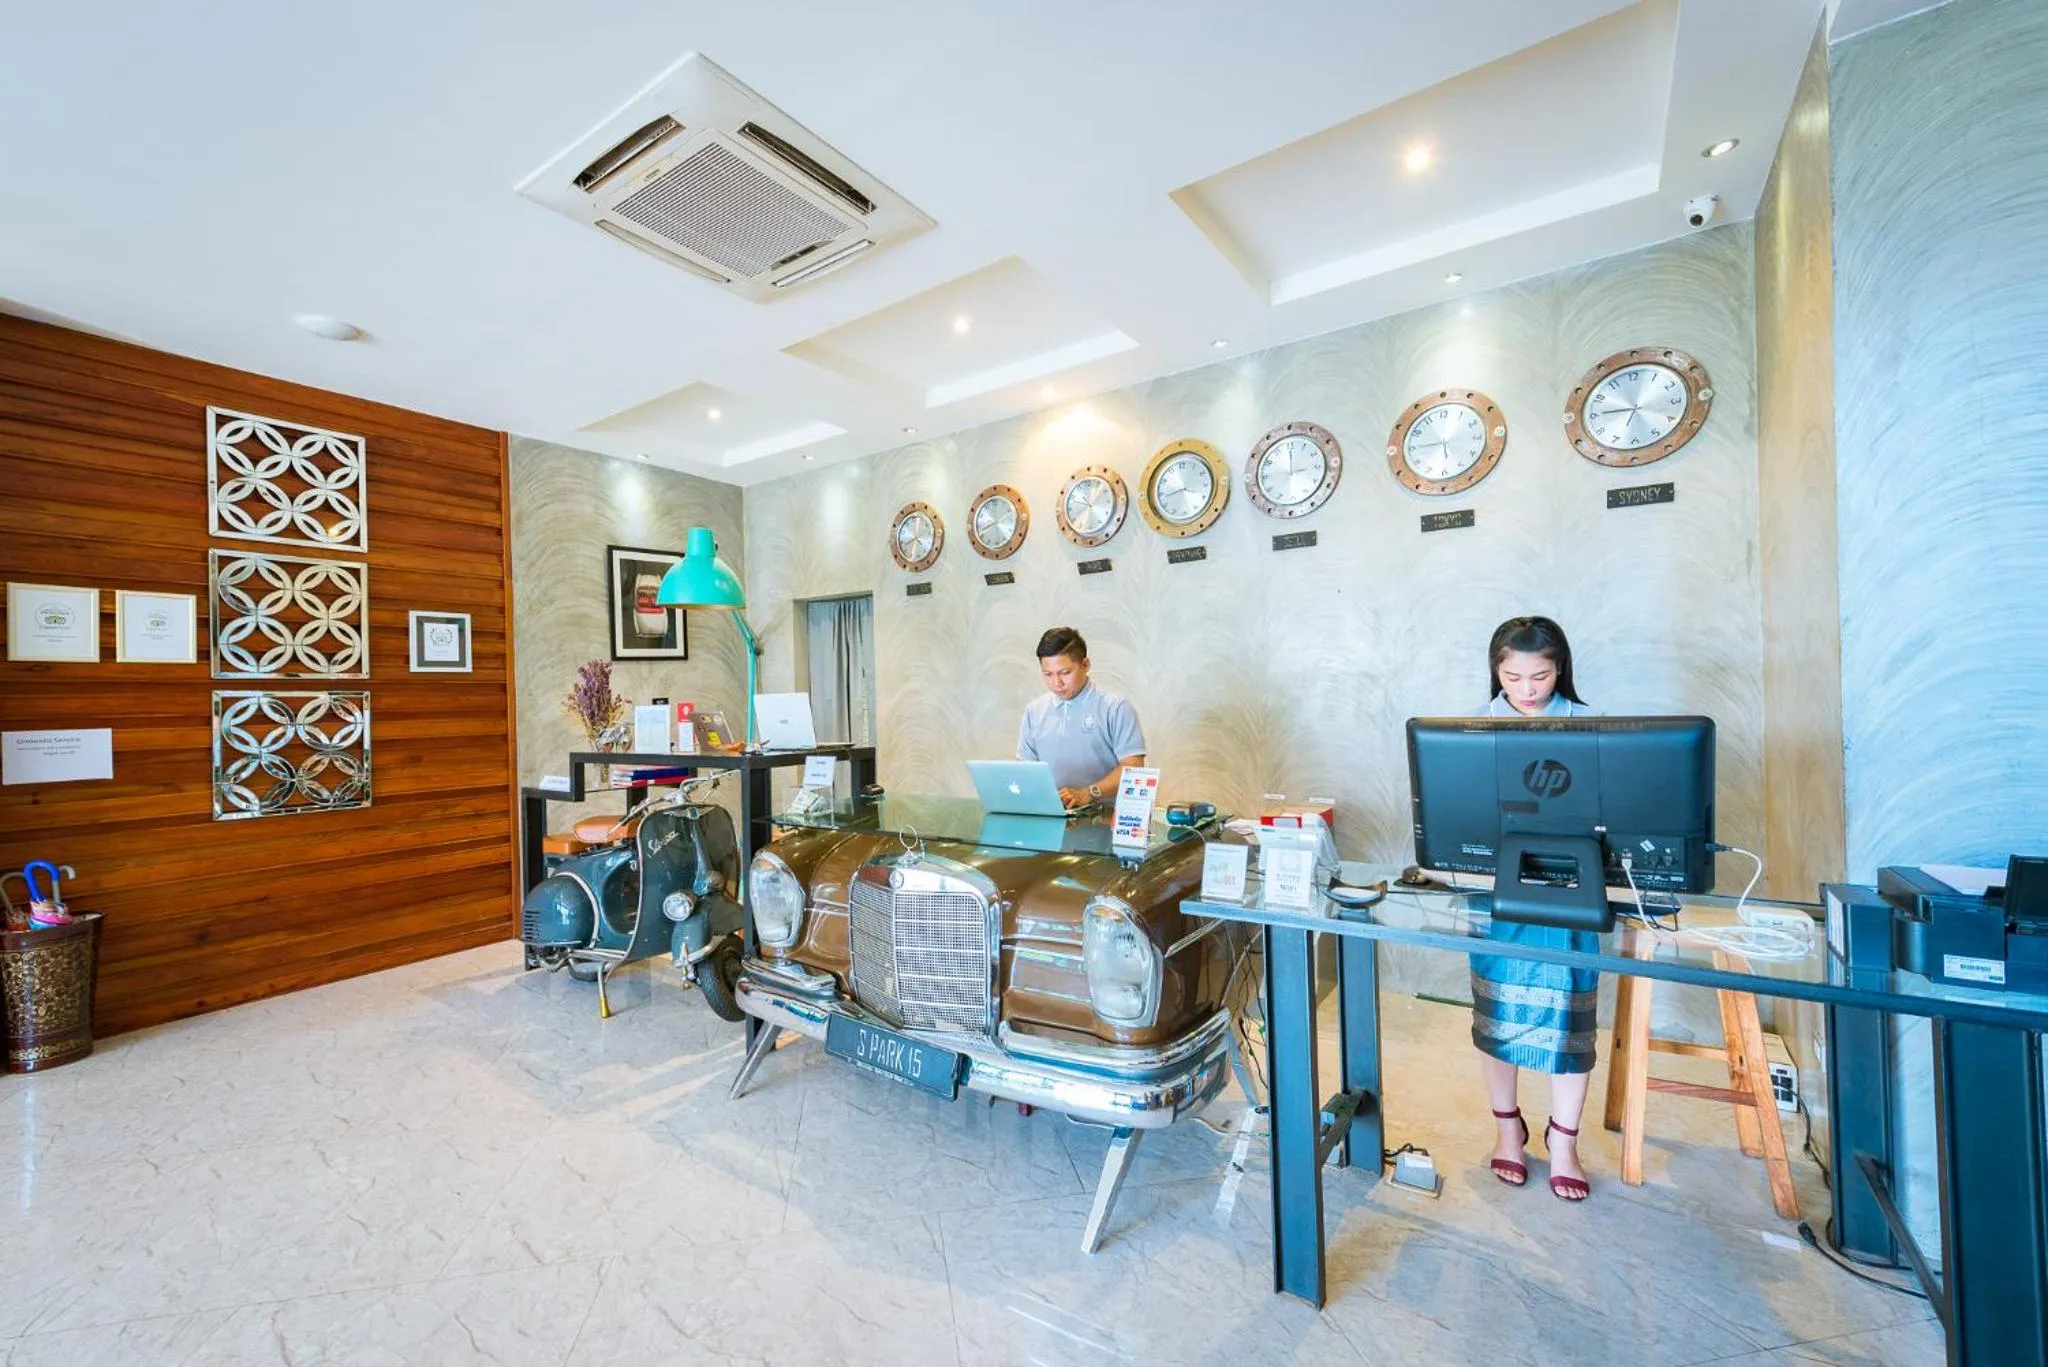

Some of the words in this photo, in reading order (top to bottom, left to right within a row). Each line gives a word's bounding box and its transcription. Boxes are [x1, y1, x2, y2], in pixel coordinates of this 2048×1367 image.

[1628, 372, 1639, 382] 12
[1651, 373, 1657, 382] 1
[1608, 380, 1621, 390] 11
[1665, 381, 1675, 391] 2
[1594, 394, 1606, 403] 10
[1651, 428, 1660, 437] 5
[1612, 435, 1621, 444] 7
[1618, 487, 1662, 505] SYDNEY
[1529, 759, 1568, 798] hp
[908, 1047, 922, 1078] 15
